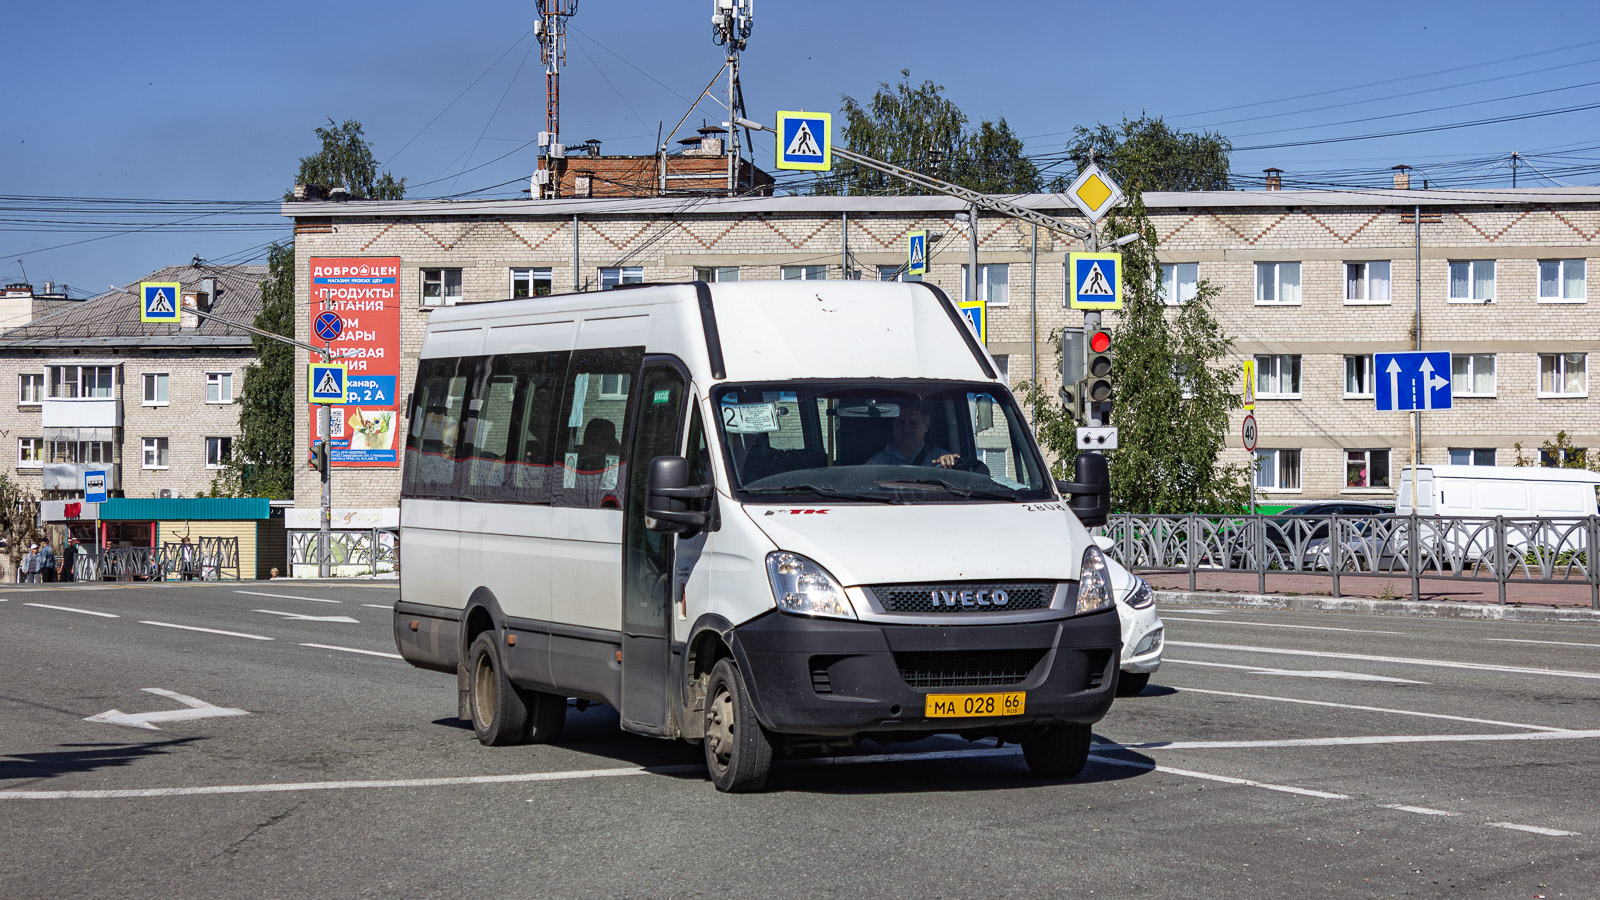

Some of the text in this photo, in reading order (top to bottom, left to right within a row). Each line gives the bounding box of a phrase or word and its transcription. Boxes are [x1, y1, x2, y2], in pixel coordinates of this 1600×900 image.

[337, 330, 376, 341] ВАРЫ
[320, 347, 385, 358] ЫТОВАЯ
[347, 380, 379, 389] канар,
[363, 390, 372, 401] 2
[374, 390, 385, 401] А
[724, 406, 738, 428] 2
[1245, 426, 1254, 440] 40
[931, 590, 1009, 607] IVECO
[934, 695, 1020, 714] МА 028 66
